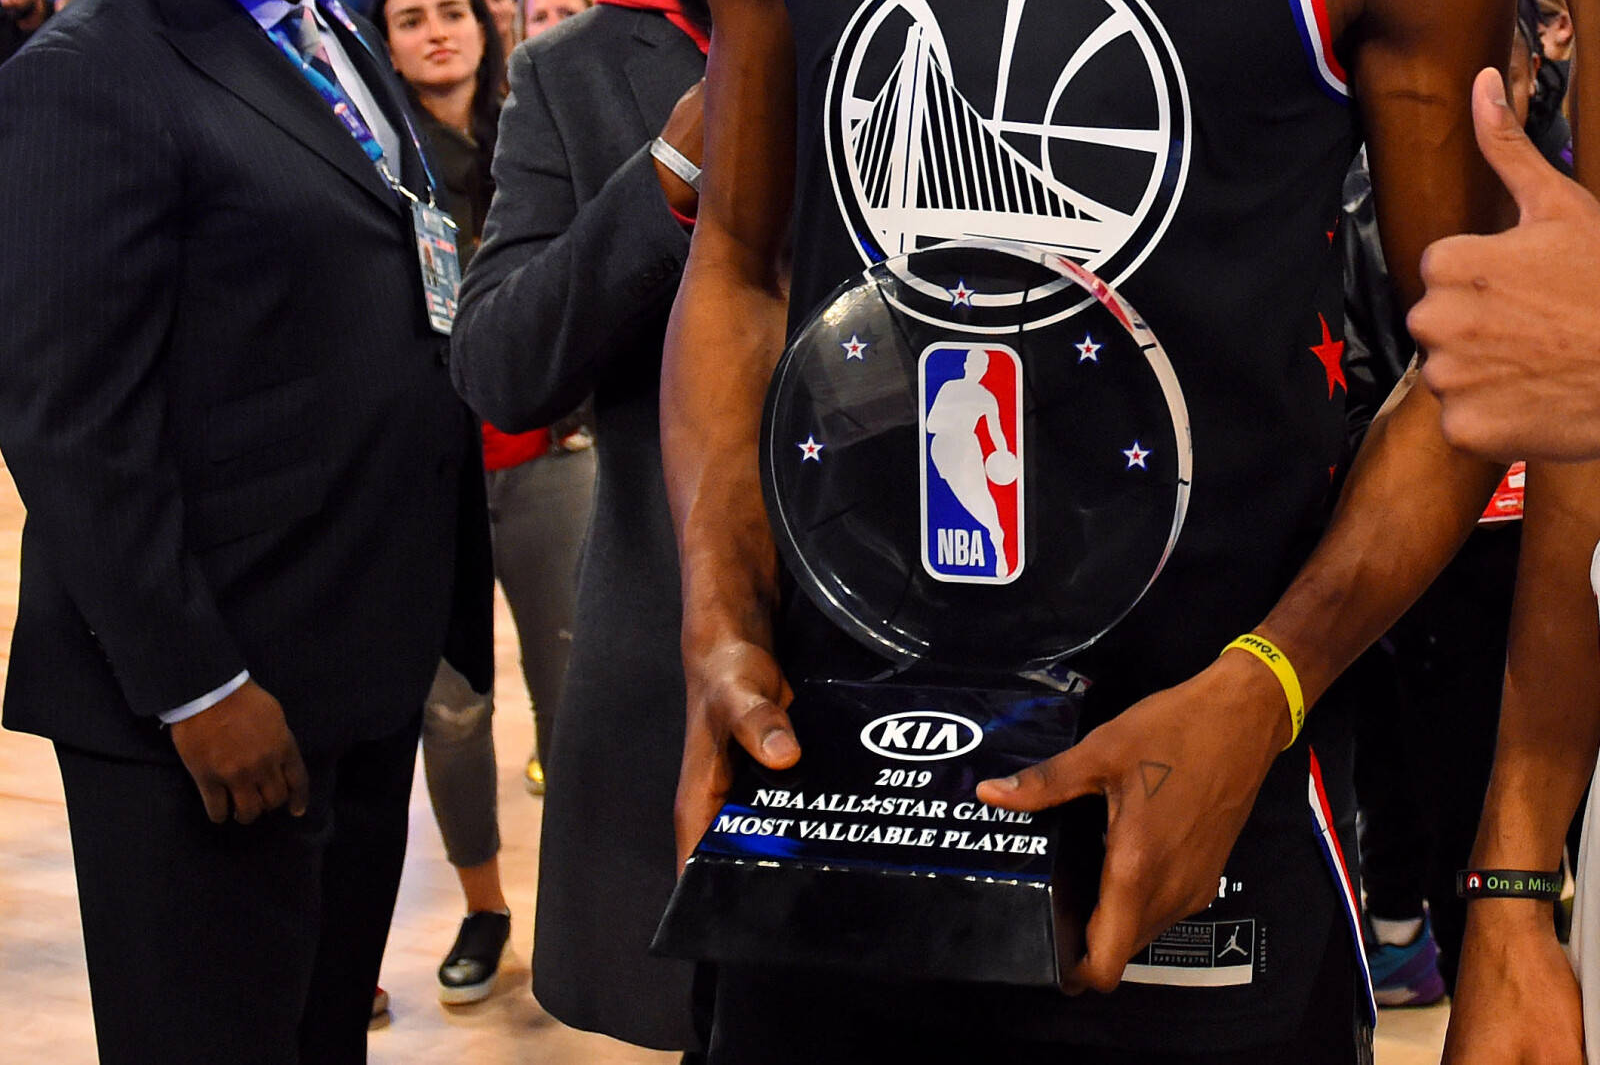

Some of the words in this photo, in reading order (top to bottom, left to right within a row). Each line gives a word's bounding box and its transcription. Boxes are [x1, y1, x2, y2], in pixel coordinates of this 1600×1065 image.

[937, 528, 985, 567] NBA
[878, 720, 958, 751] KIA
[875, 769, 932, 788] 2019
[751, 789, 805, 810] NBA
[713, 814, 794, 837] MOST
[798, 820, 937, 845] VALUABLE
[940, 830, 1048, 855] PLAYER
[1487, 876, 1509, 890] On
[1514, 880, 1523, 891] a
